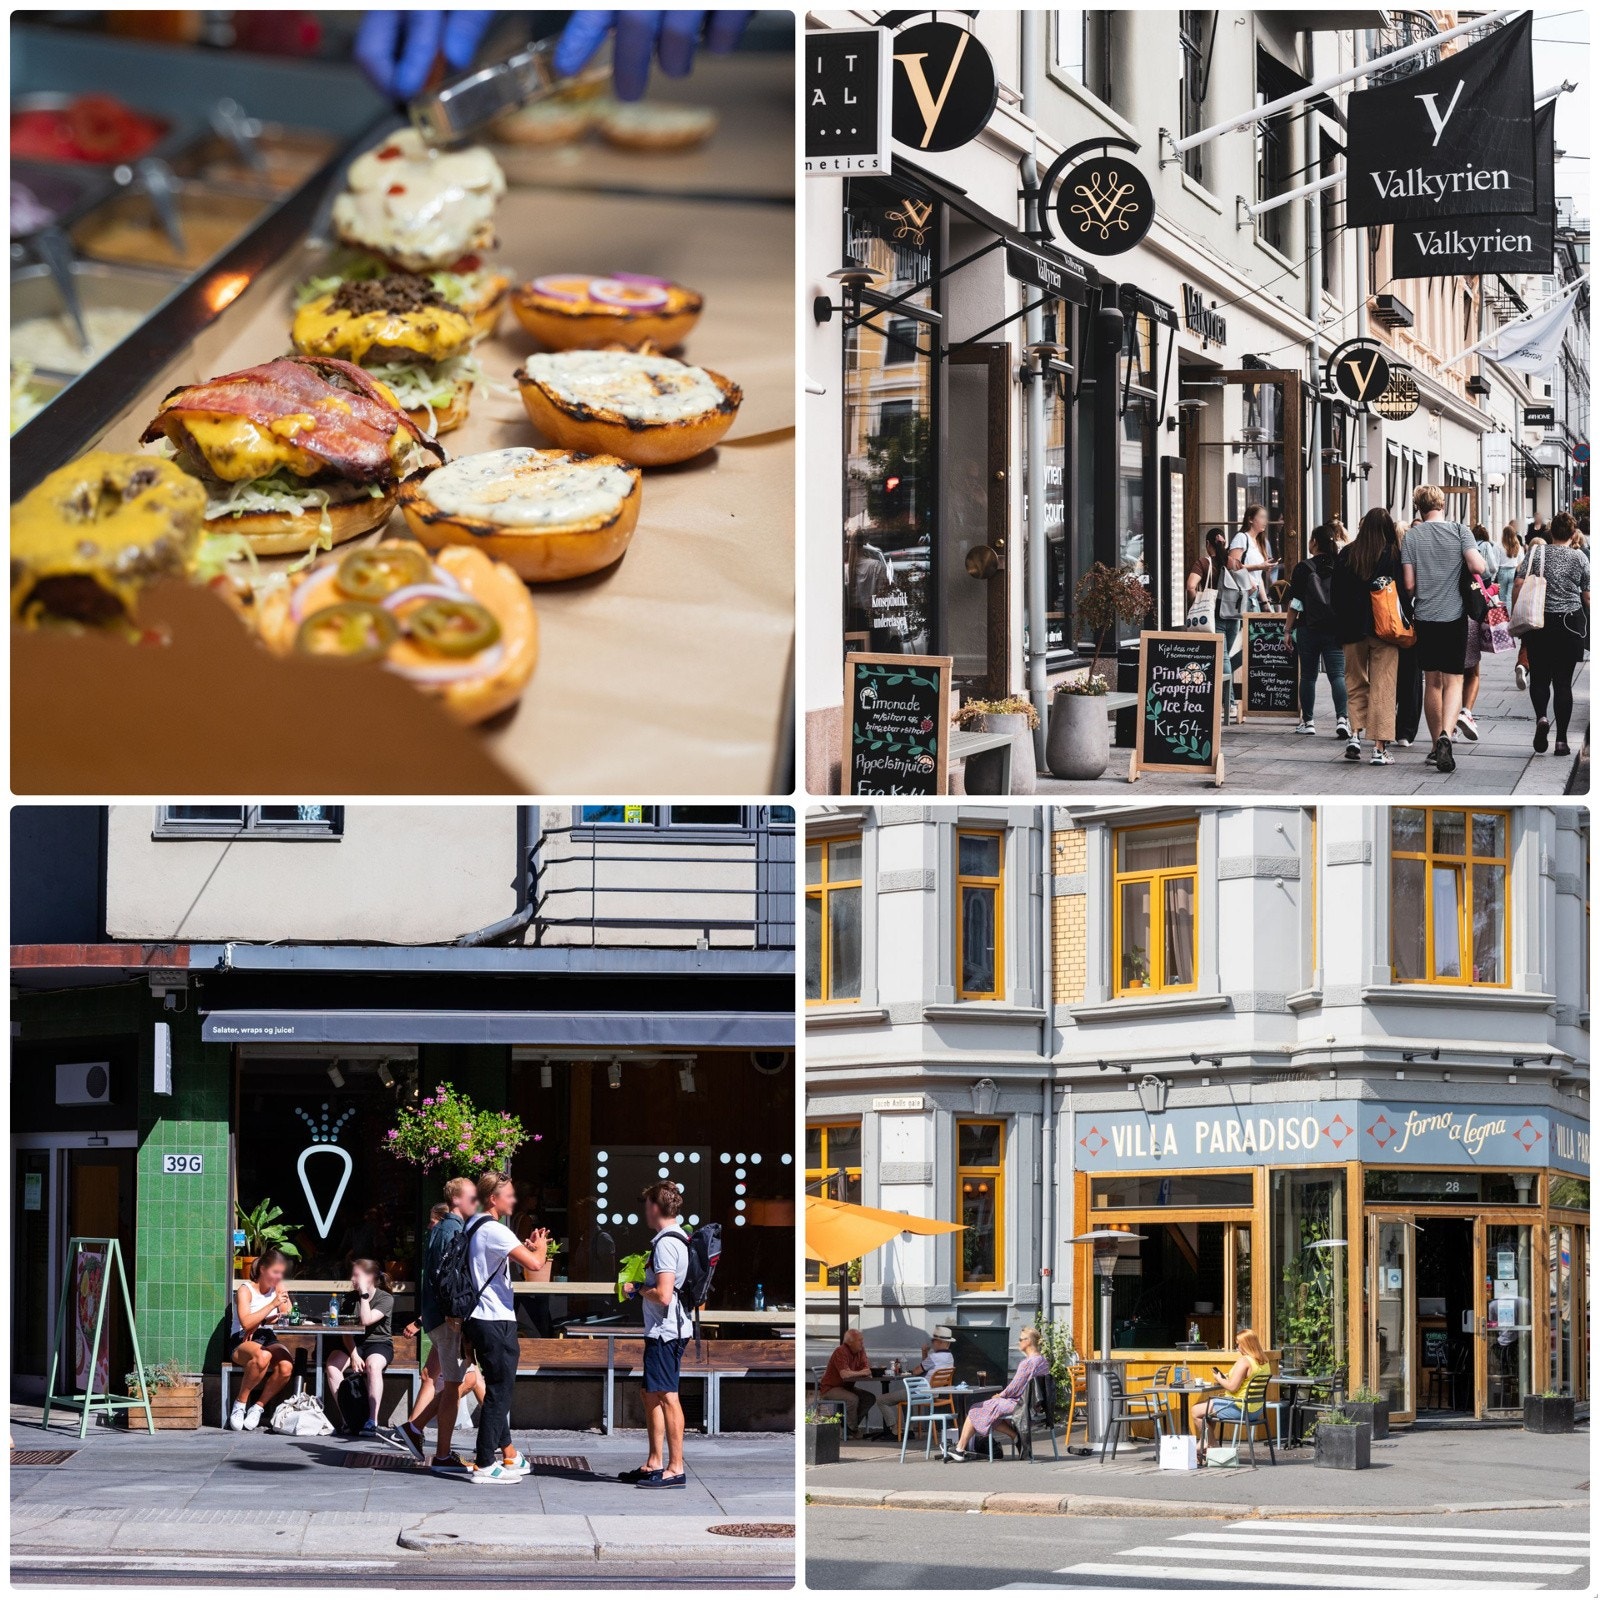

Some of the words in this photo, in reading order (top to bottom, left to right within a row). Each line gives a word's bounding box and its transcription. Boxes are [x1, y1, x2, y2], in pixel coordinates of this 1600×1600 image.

[1369, 163, 1512, 203] Valkyrien
[1413, 228, 1533, 261] Valkyrien
[1181, 282, 1227, 350] Valkyrien
[1043, 459, 1062, 490] yrien
[1152, 665, 1182, 680] Pink
[862, 694, 920, 711] Limonade
[1152, 681, 1213, 700] Grapefruit
[1162, 700, 1181, 713] Ice
[1182, 700, 1205, 713] tea
[856, 753, 932, 778] Appelsinjuice
[212, 1026, 240, 1034] Salater,
[263, 1027, 274, 1035] og
[274, 1026, 295, 1035] juice!
[1111, 1123, 1179, 1157] VILLA
[1195, 1116, 1320, 1154] PARADISO
[1393, 1110, 1453, 1153] forno
[1448, 1122, 1462, 1140] a
[1463, 1113, 1507, 1155] legna
[1445, 1182, 1460, 1192] 28
